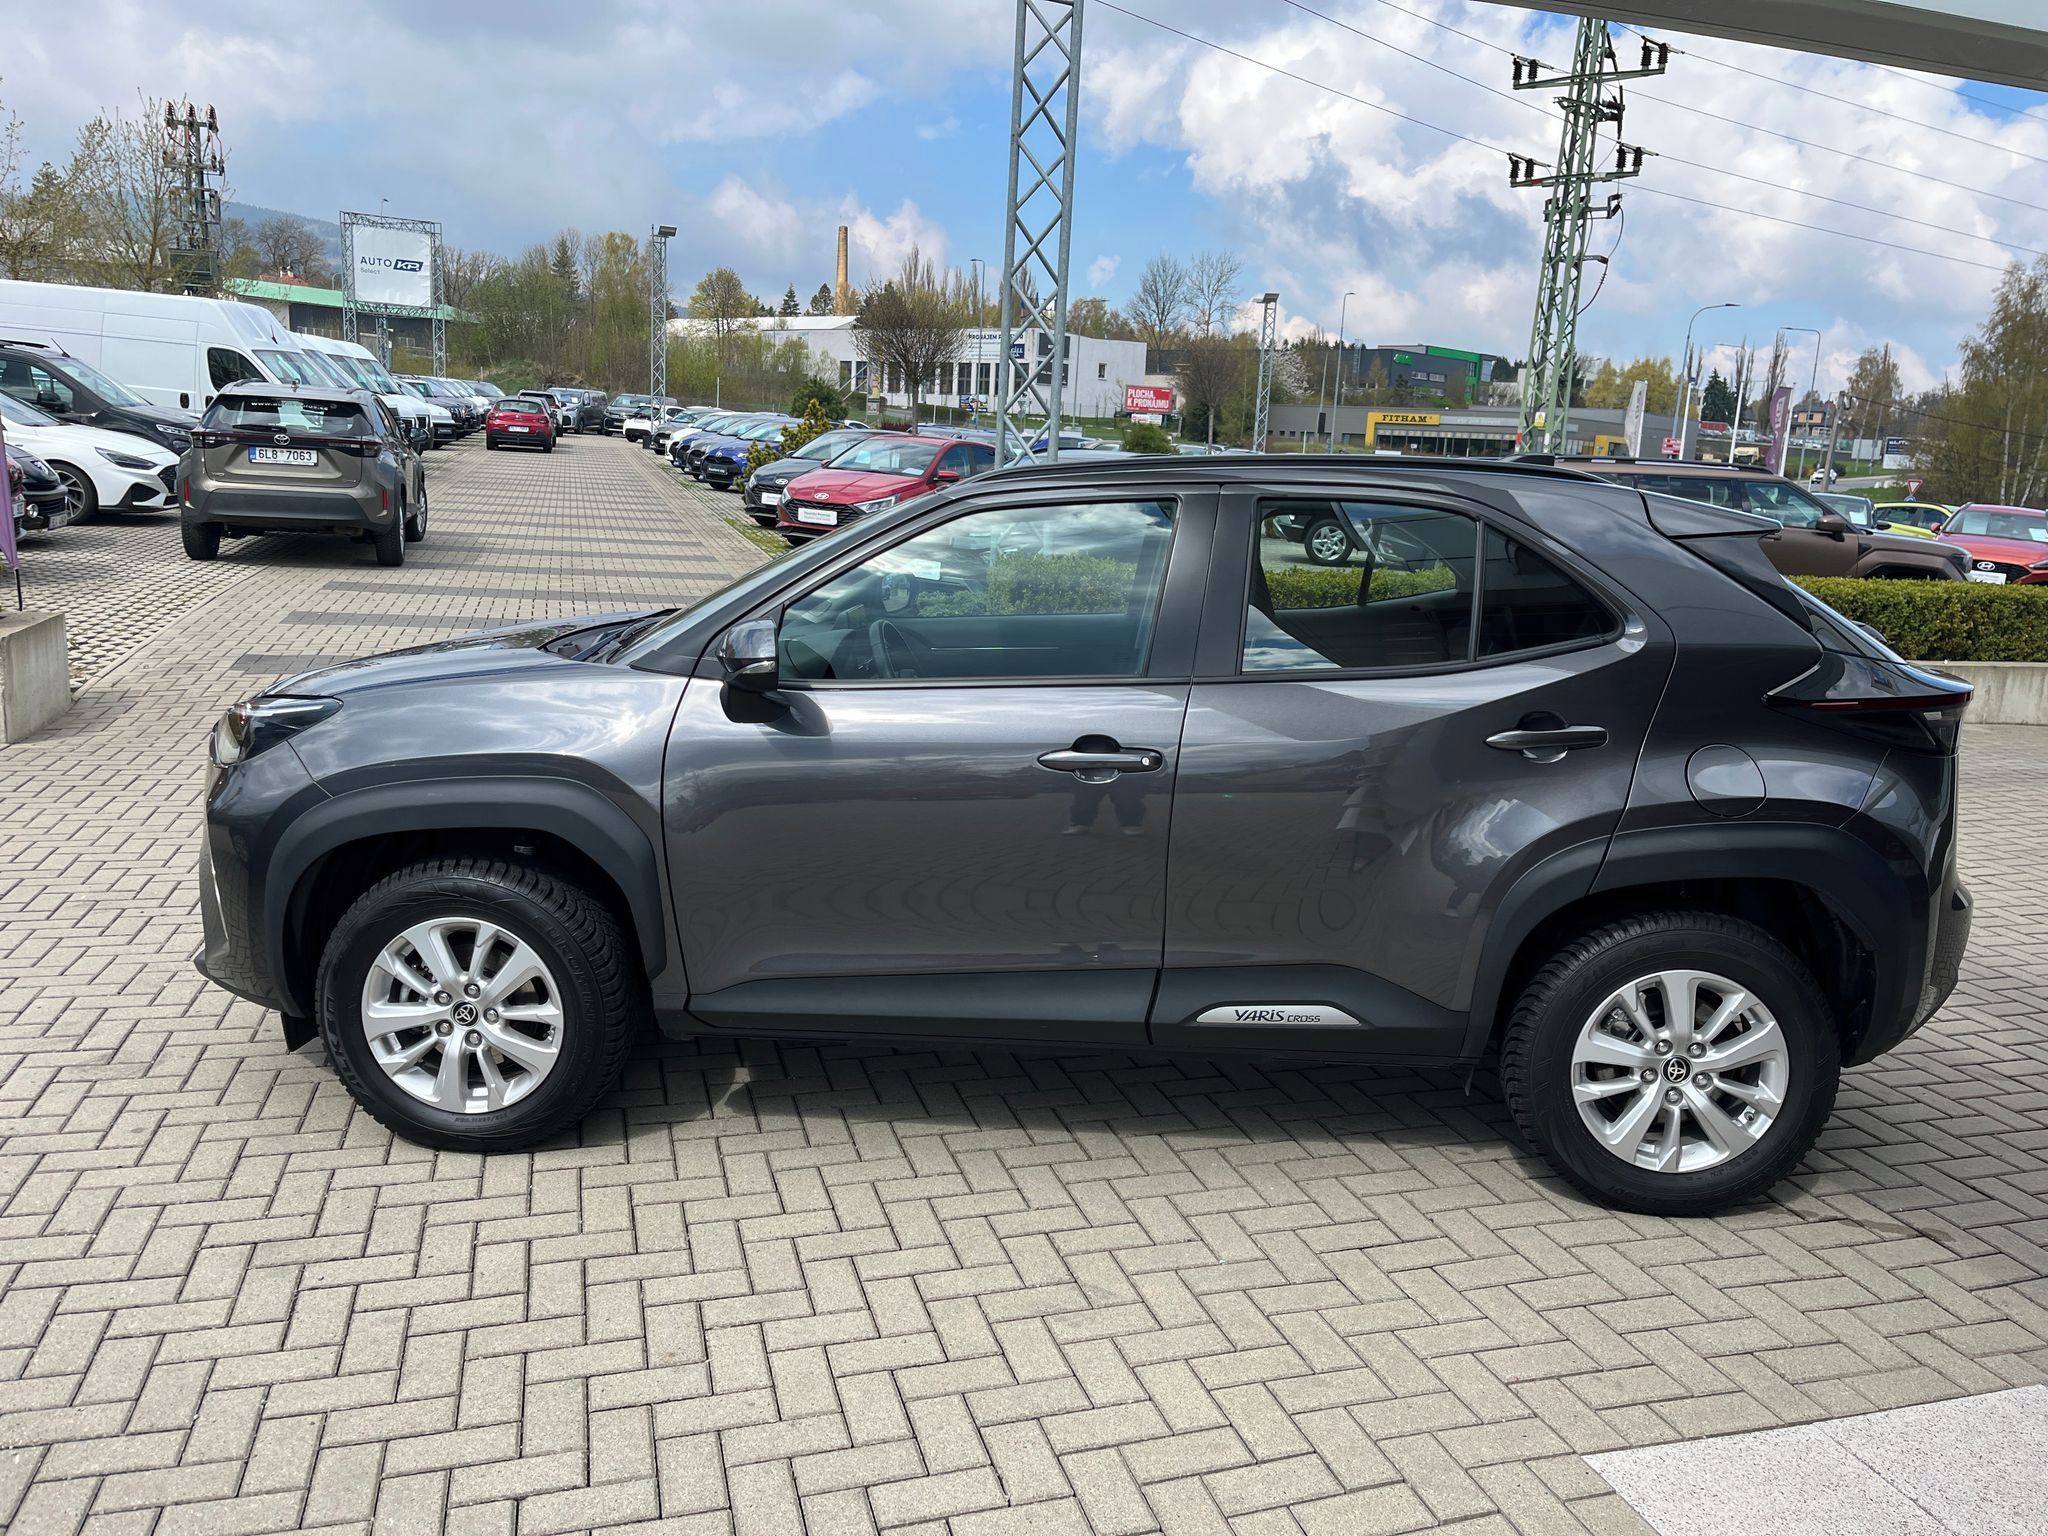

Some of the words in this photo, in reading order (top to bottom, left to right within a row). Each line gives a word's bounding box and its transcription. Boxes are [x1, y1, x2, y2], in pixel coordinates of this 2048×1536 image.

[360, 256, 392, 268] AUTO
[360, 266, 380, 275] Select
[1127, 397, 1133, 407] K
[1382, 414, 1427, 423] FITHAM
[258, 448, 278, 460] 6L8
[286, 450, 312, 462] 7063
[1286, 1015, 1321, 1023] CROSS
